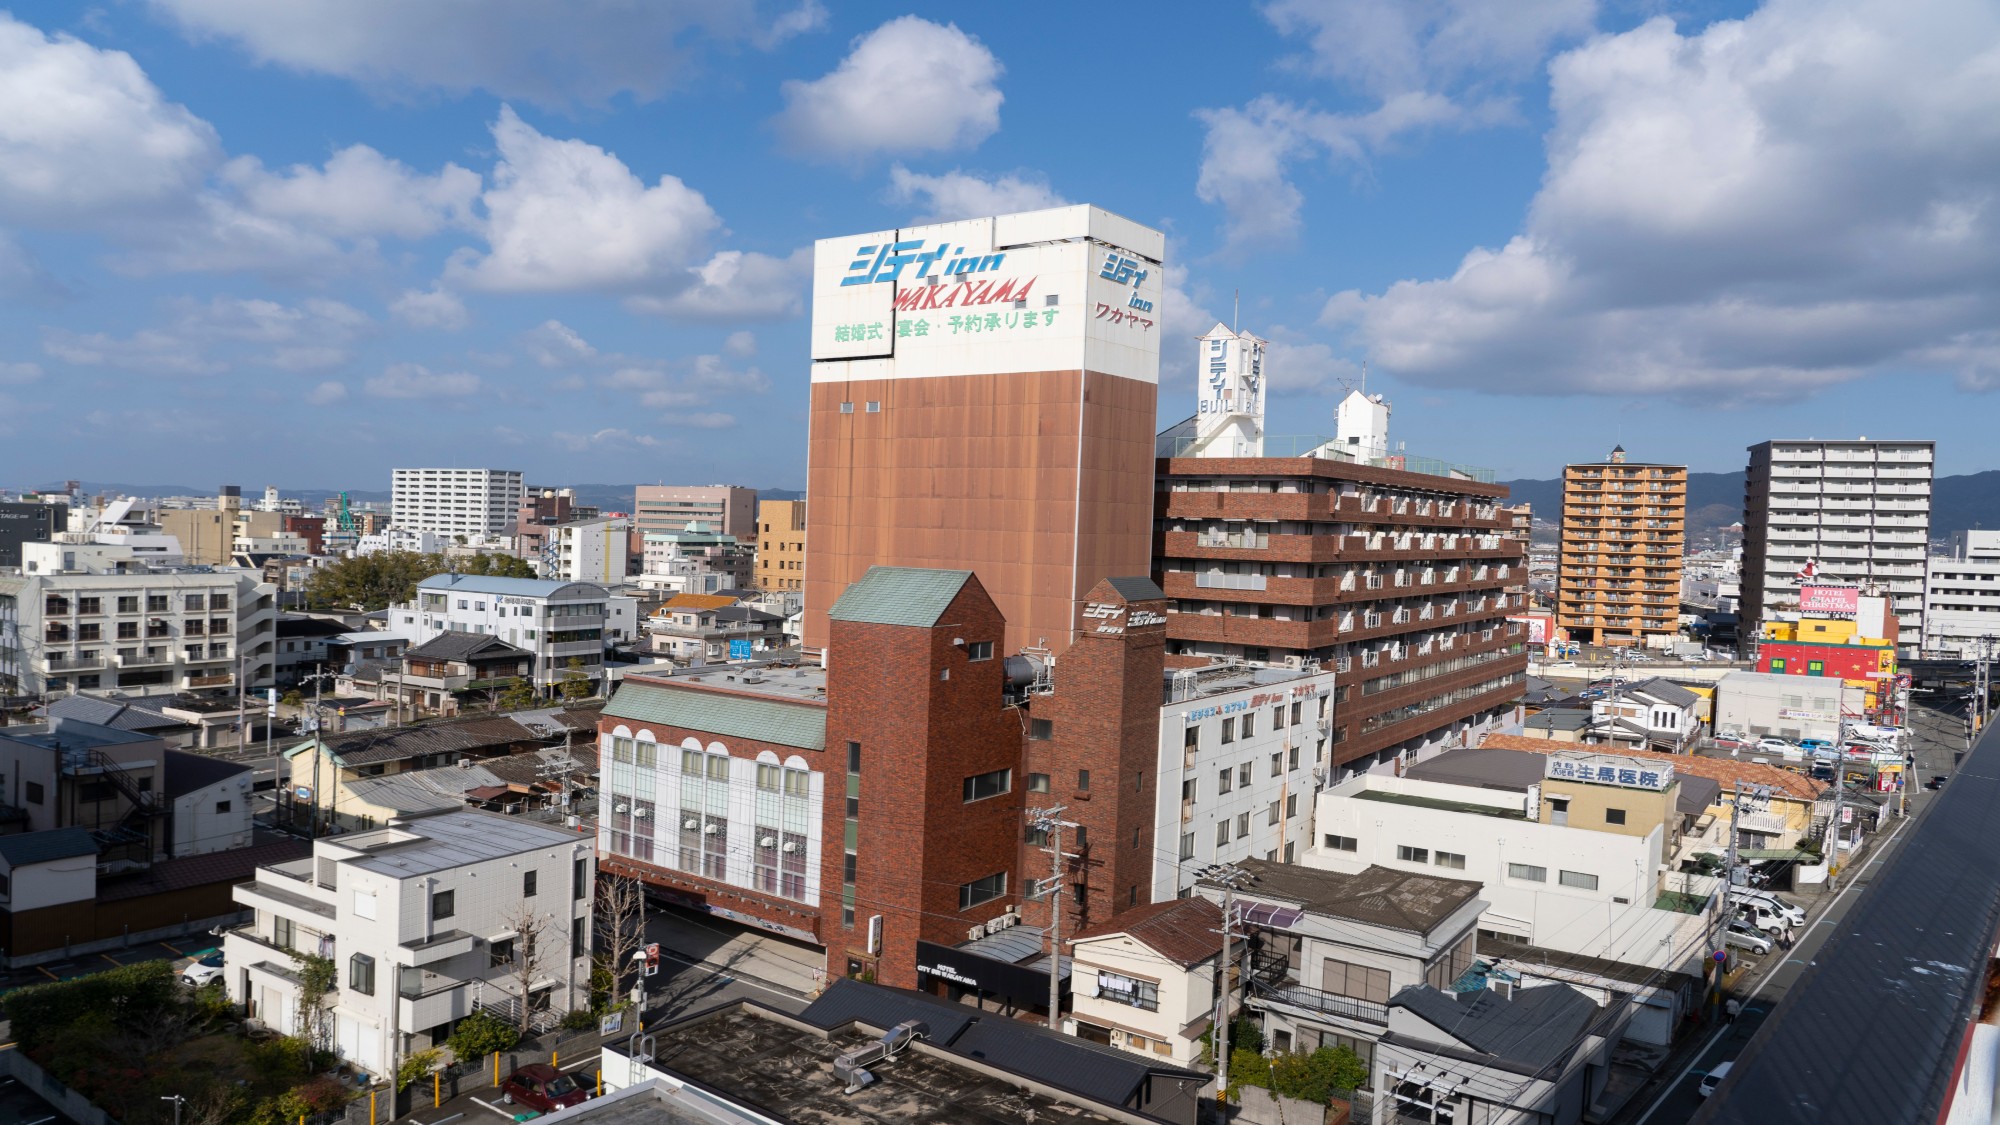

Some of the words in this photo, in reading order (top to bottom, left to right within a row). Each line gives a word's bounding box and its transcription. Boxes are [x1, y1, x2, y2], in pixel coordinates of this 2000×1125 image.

[944, 247, 1007, 276] inn
[890, 275, 1039, 313] WAKAYAMA
[1127, 290, 1154, 314] inn
[1095, 301, 1154, 331] ワカヤマ
[1801, 601, 1856, 609] CHRISTMAS
[1810, 596, 1847, 604] CHAPEL
[1096, 621, 1124, 634] inn
[1552, 761, 1574, 769] 内科
[917, 964, 931, 973] CITY
[941, 971, 977, 985] WAKAYAMA
[937, 963, 958, 975] HOTEL
